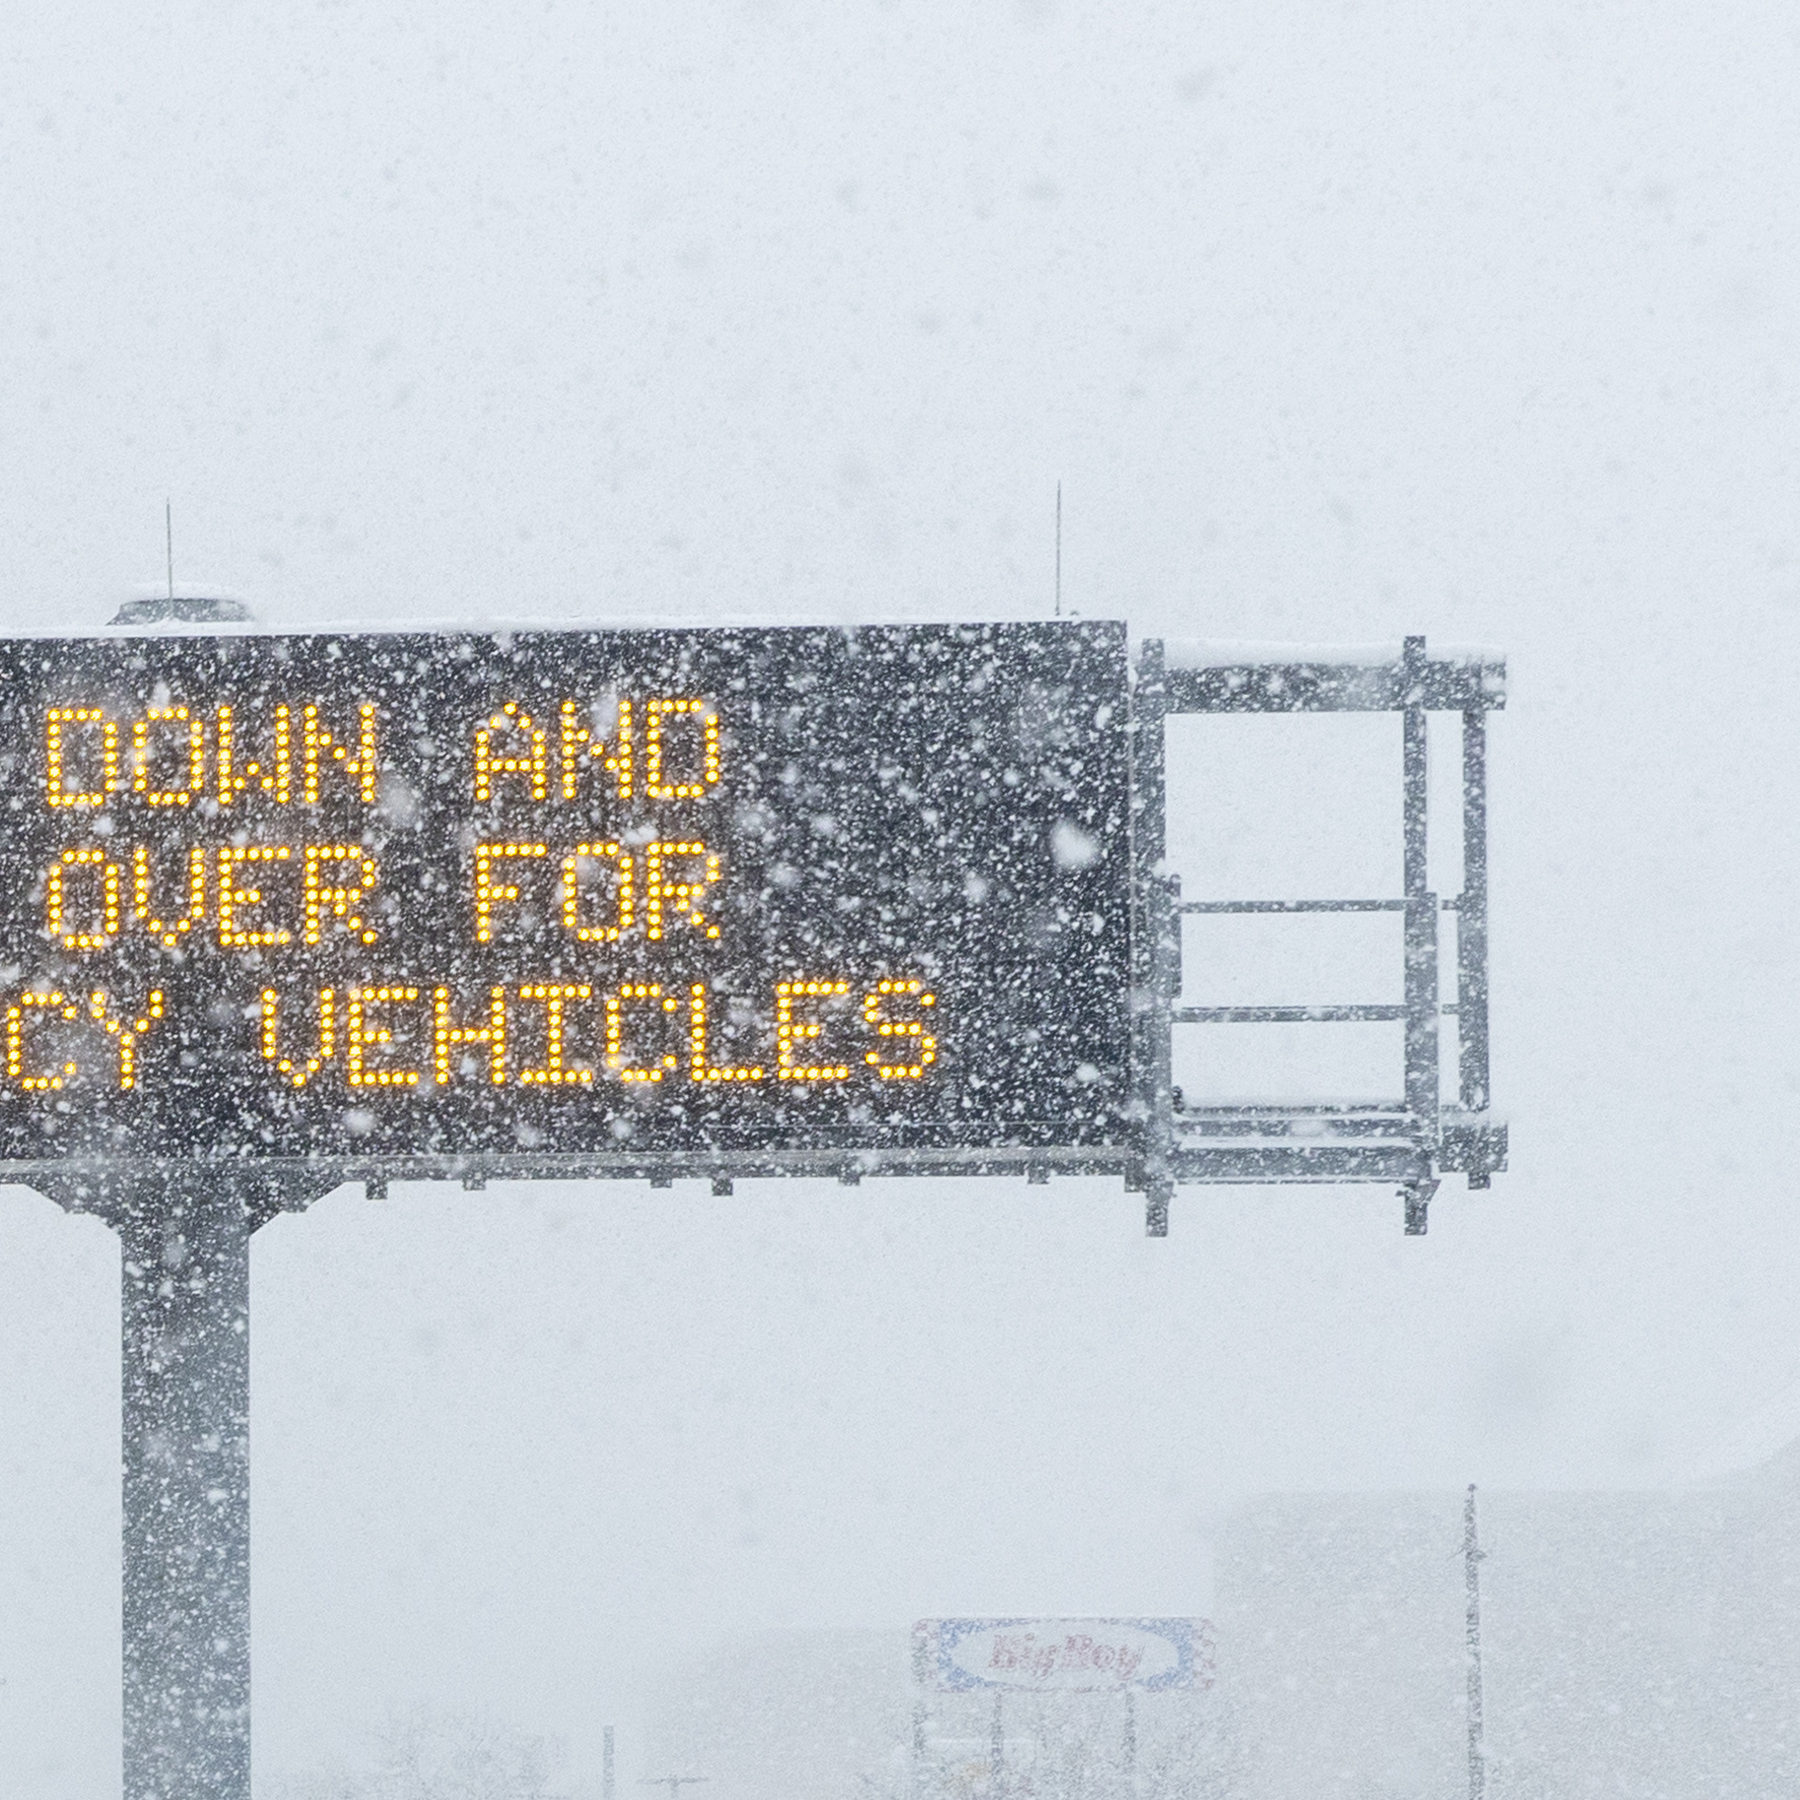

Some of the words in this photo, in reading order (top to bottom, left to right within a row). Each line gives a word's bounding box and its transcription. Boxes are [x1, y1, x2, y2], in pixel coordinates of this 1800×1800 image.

[46, 703, 377, 809] DOWN
[475, 698, 721, 801] AND
[46, 844, 378, 950] OVER
[474, 840, 721, 942] FOR
[260, 978, 937, 1088] VEHICLES
[988, 1634, 1059, 1681] Big
[1060, 1634, 1144, 1681] Boy
